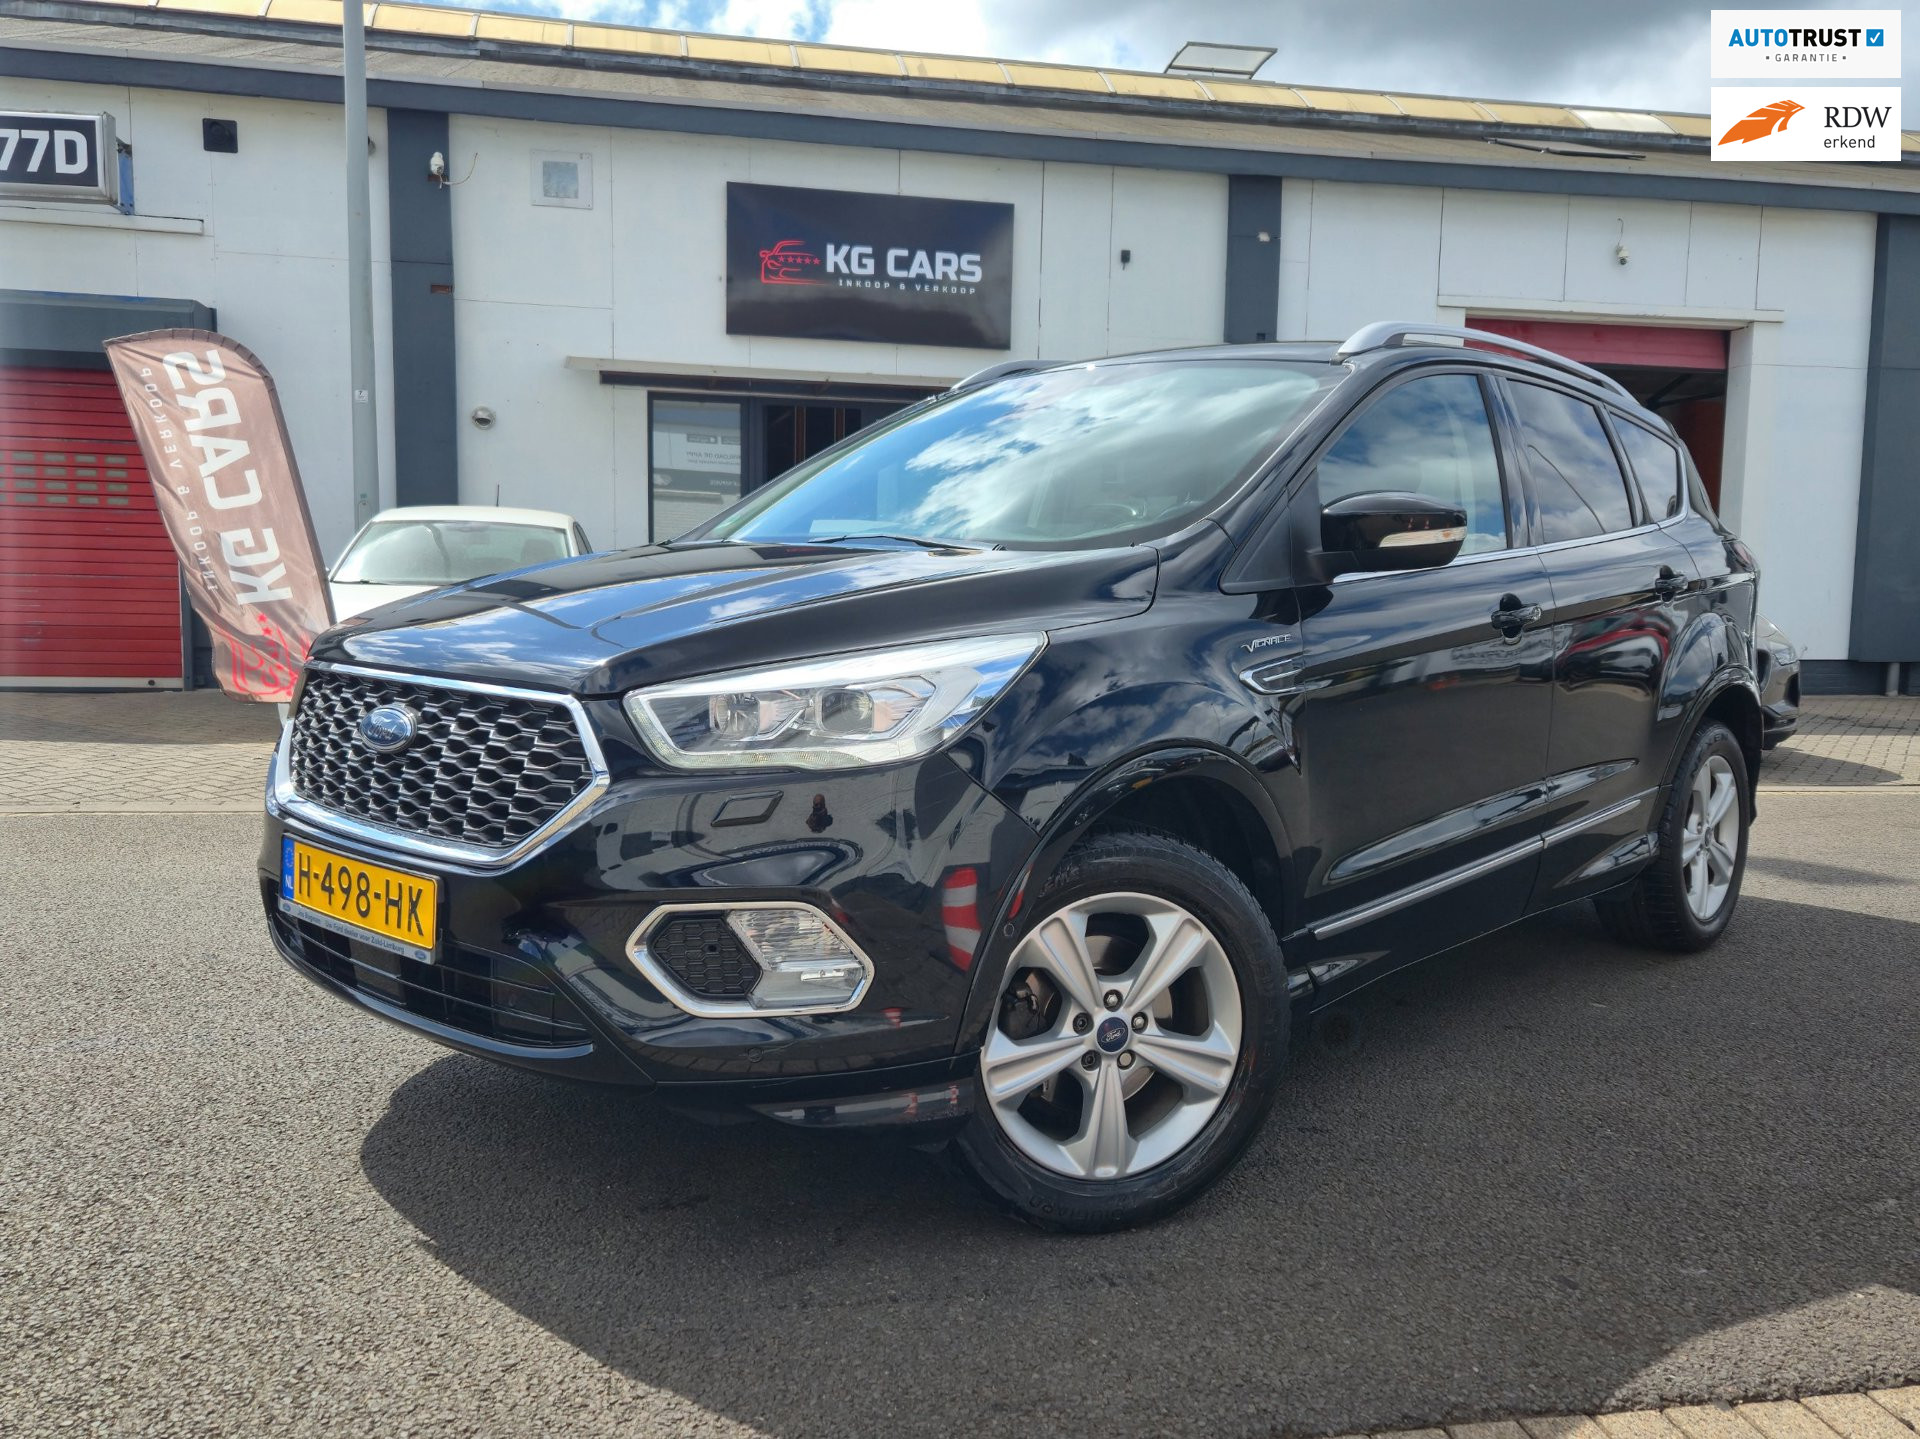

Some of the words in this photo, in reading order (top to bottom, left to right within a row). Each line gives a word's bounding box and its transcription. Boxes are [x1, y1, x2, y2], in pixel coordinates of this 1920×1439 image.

[0, 128, 88, 174] 77D
[826, 243, 875, 275] KG
[886, 248, 982, 283] CARS
[838, 279, 890, 289] INKOOP
[915, 284, 976, 294] VERKOOP
[367, 711, 398, 740] Ford
[285, 874, 293, 890] NL
[298, 852, 424, 937] H-498-HK
[1105, 1030, 1121, 1042] Ford
